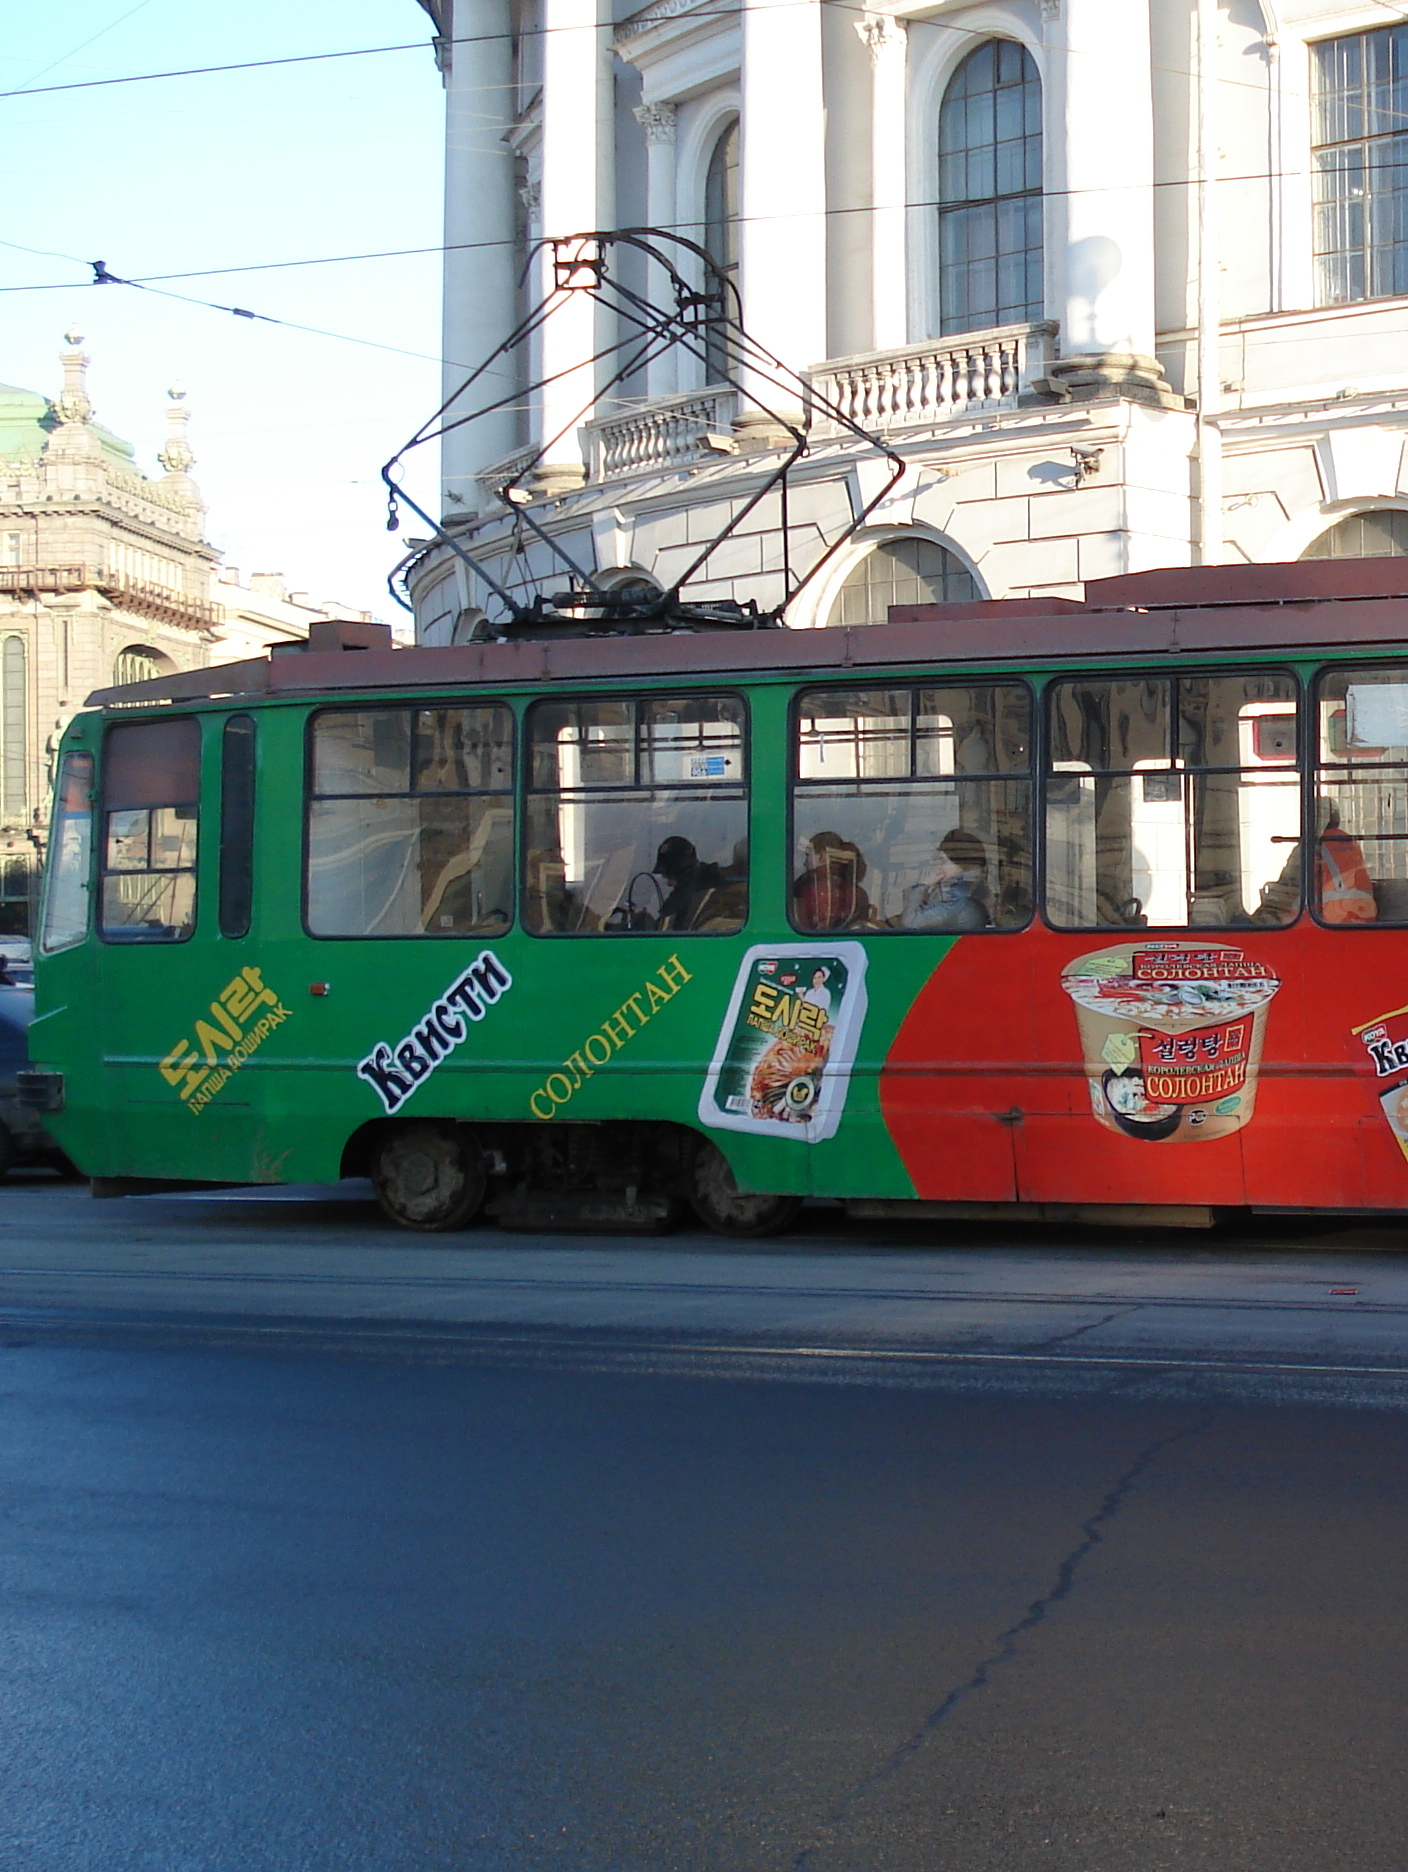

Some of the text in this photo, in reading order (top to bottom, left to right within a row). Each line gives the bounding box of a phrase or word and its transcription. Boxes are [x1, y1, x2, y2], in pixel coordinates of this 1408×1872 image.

[750, 983, 829, 1041] 도시락
[1137, 966, 1268, 979] СОЛОНТАН
[159, 966, 278, 1100] 도시락
[187, 1002, 294, 1116] ЛАПША ДОШИРАК
[529, 953, 694, 1121] СОЛОНТАН
[1147, 1060, 1246, 1098] СОЛОНТАН
